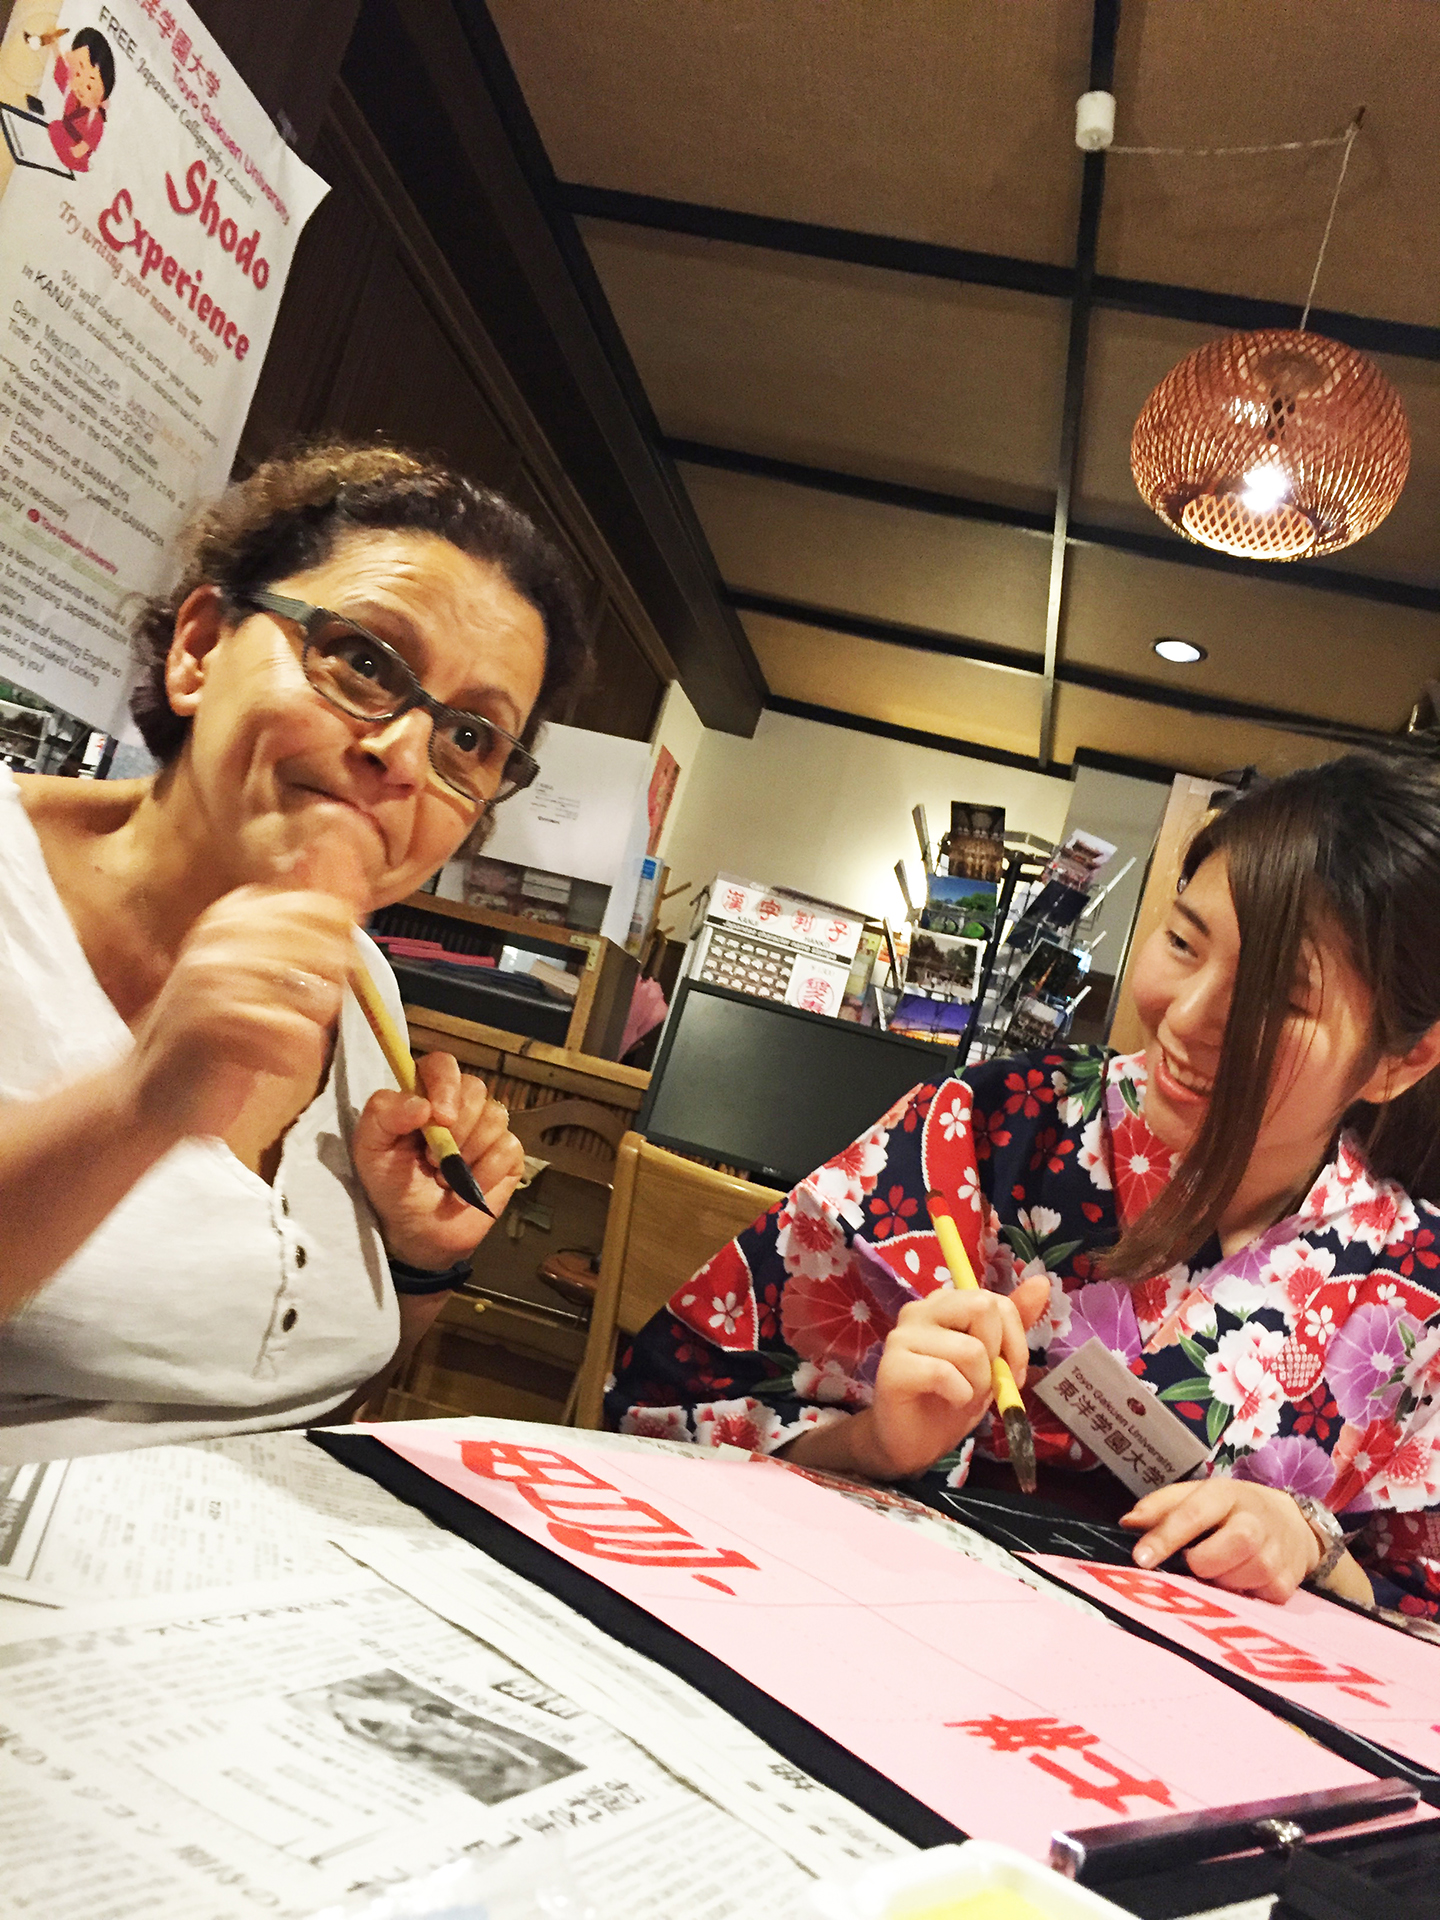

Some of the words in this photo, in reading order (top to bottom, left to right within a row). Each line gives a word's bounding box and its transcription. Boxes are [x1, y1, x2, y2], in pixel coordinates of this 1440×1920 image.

[99, 5, 137, 60] FREE
[136, 57, 179, 112] Japanese
[59, 200, 81, 234] Try
[81, 227, 123, 279] writing
[120, 269, 149, 297] your
[149, 295, 175, 325] name
[166, 161, 269, 289] Shodo
[34, 270, 73, 310] KANJI
[99, 190, 248, 359] Experience
[29, 358, 50, 381] One
[165, 370, 184, 388] your
[184, 386, 202, 406] name
[14, 411, 43, 443] Dining
[44, 433, 70, 460] Room
[100, 435, 126, 464] Dining
[125, 454, 146, 477] Room
[63, 603, 101, 629] Japanese
[1053, 1376, 1166, 1487] 東洋学園大学
[1071, 1365, 1094, 1391] Toyo
[1092, 1389, 1129, 1429] Gakuen
[1127, 1422, 1177, 1474] University
